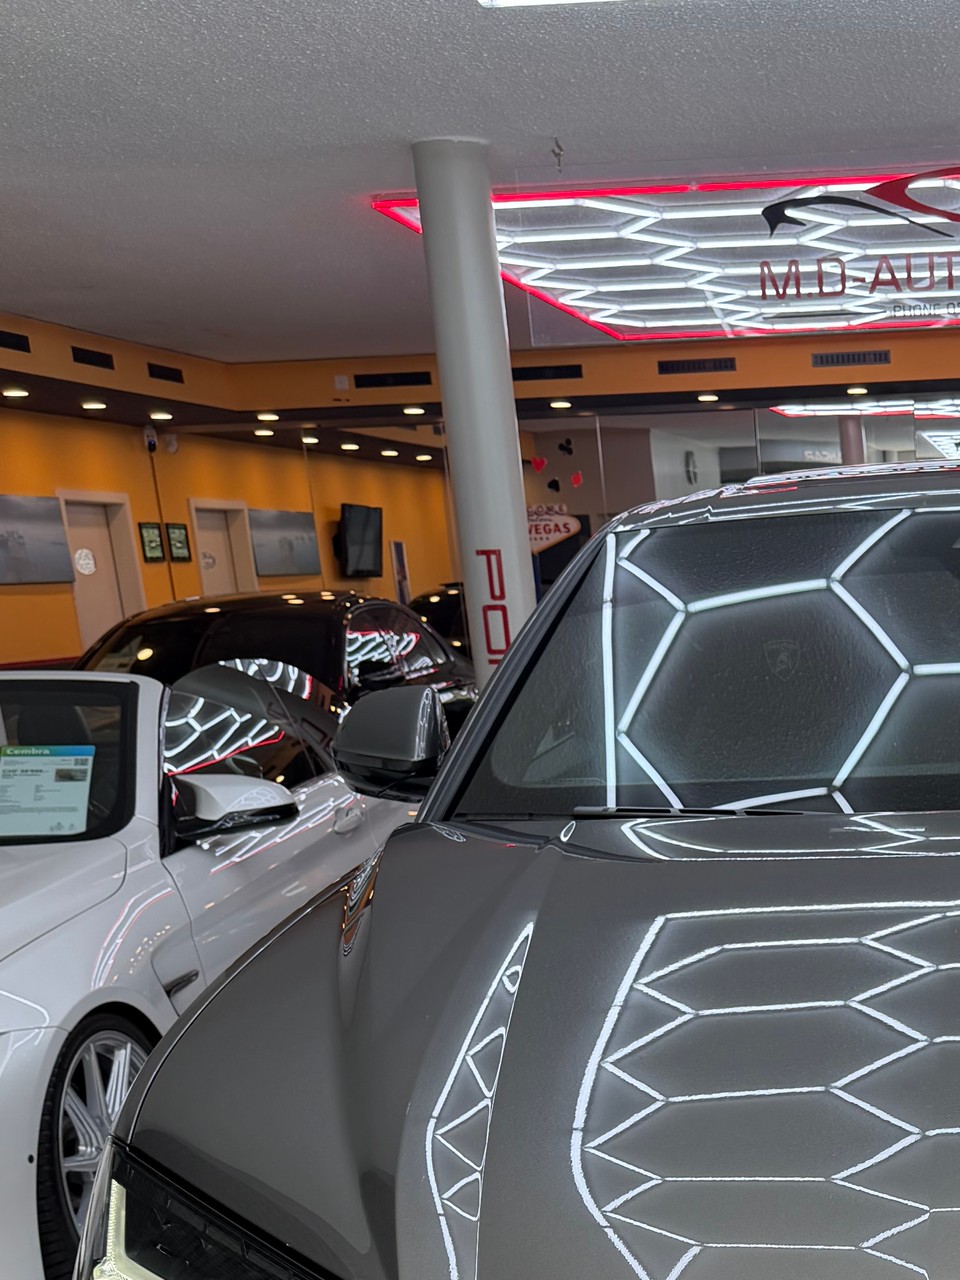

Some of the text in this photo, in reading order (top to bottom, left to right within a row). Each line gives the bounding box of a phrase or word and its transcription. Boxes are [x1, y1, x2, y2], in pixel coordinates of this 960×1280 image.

[892, 303, 941, 317] PHONE
[475, 549, 511, 665] PO
[6, 747, 51, 755] Cembra
